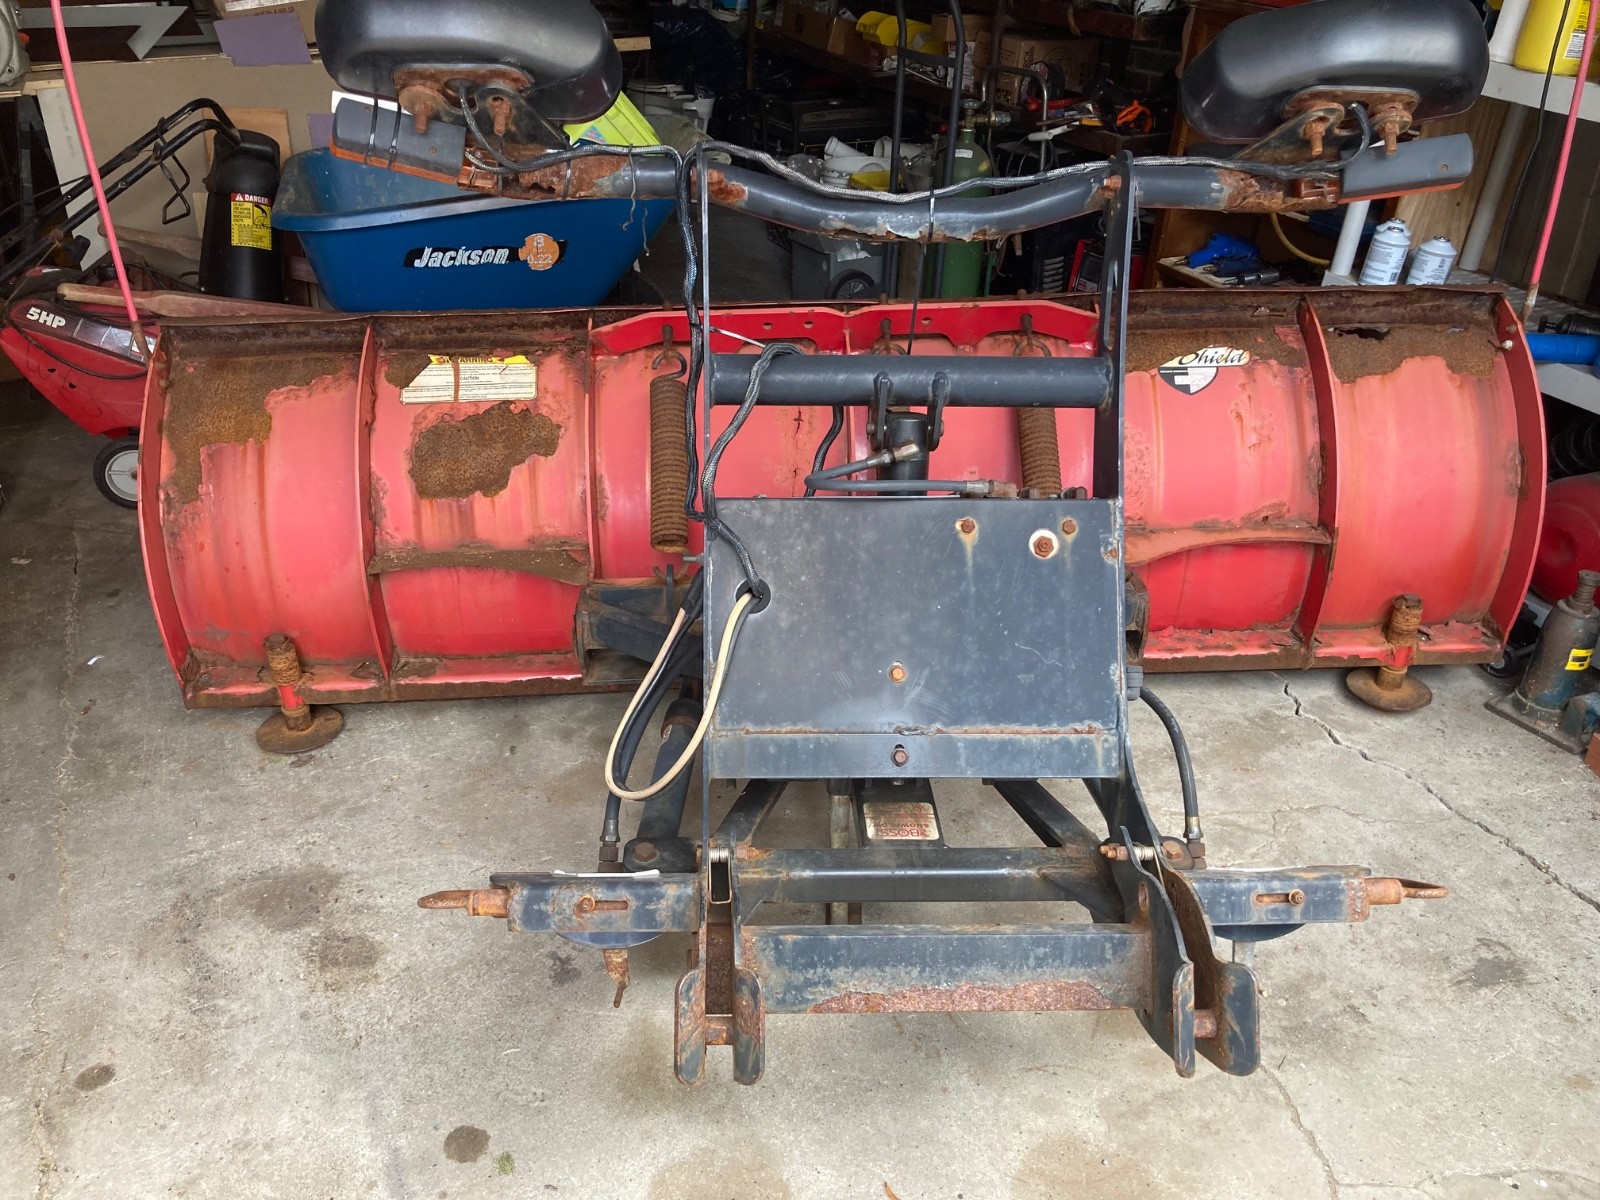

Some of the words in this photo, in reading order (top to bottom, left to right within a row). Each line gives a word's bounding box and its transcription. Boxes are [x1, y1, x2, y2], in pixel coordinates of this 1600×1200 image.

[244, 194, 268, 204] DANGER
[414, 246, 509, 268] Jackson
[26, 306, 66, 328] 5HP
